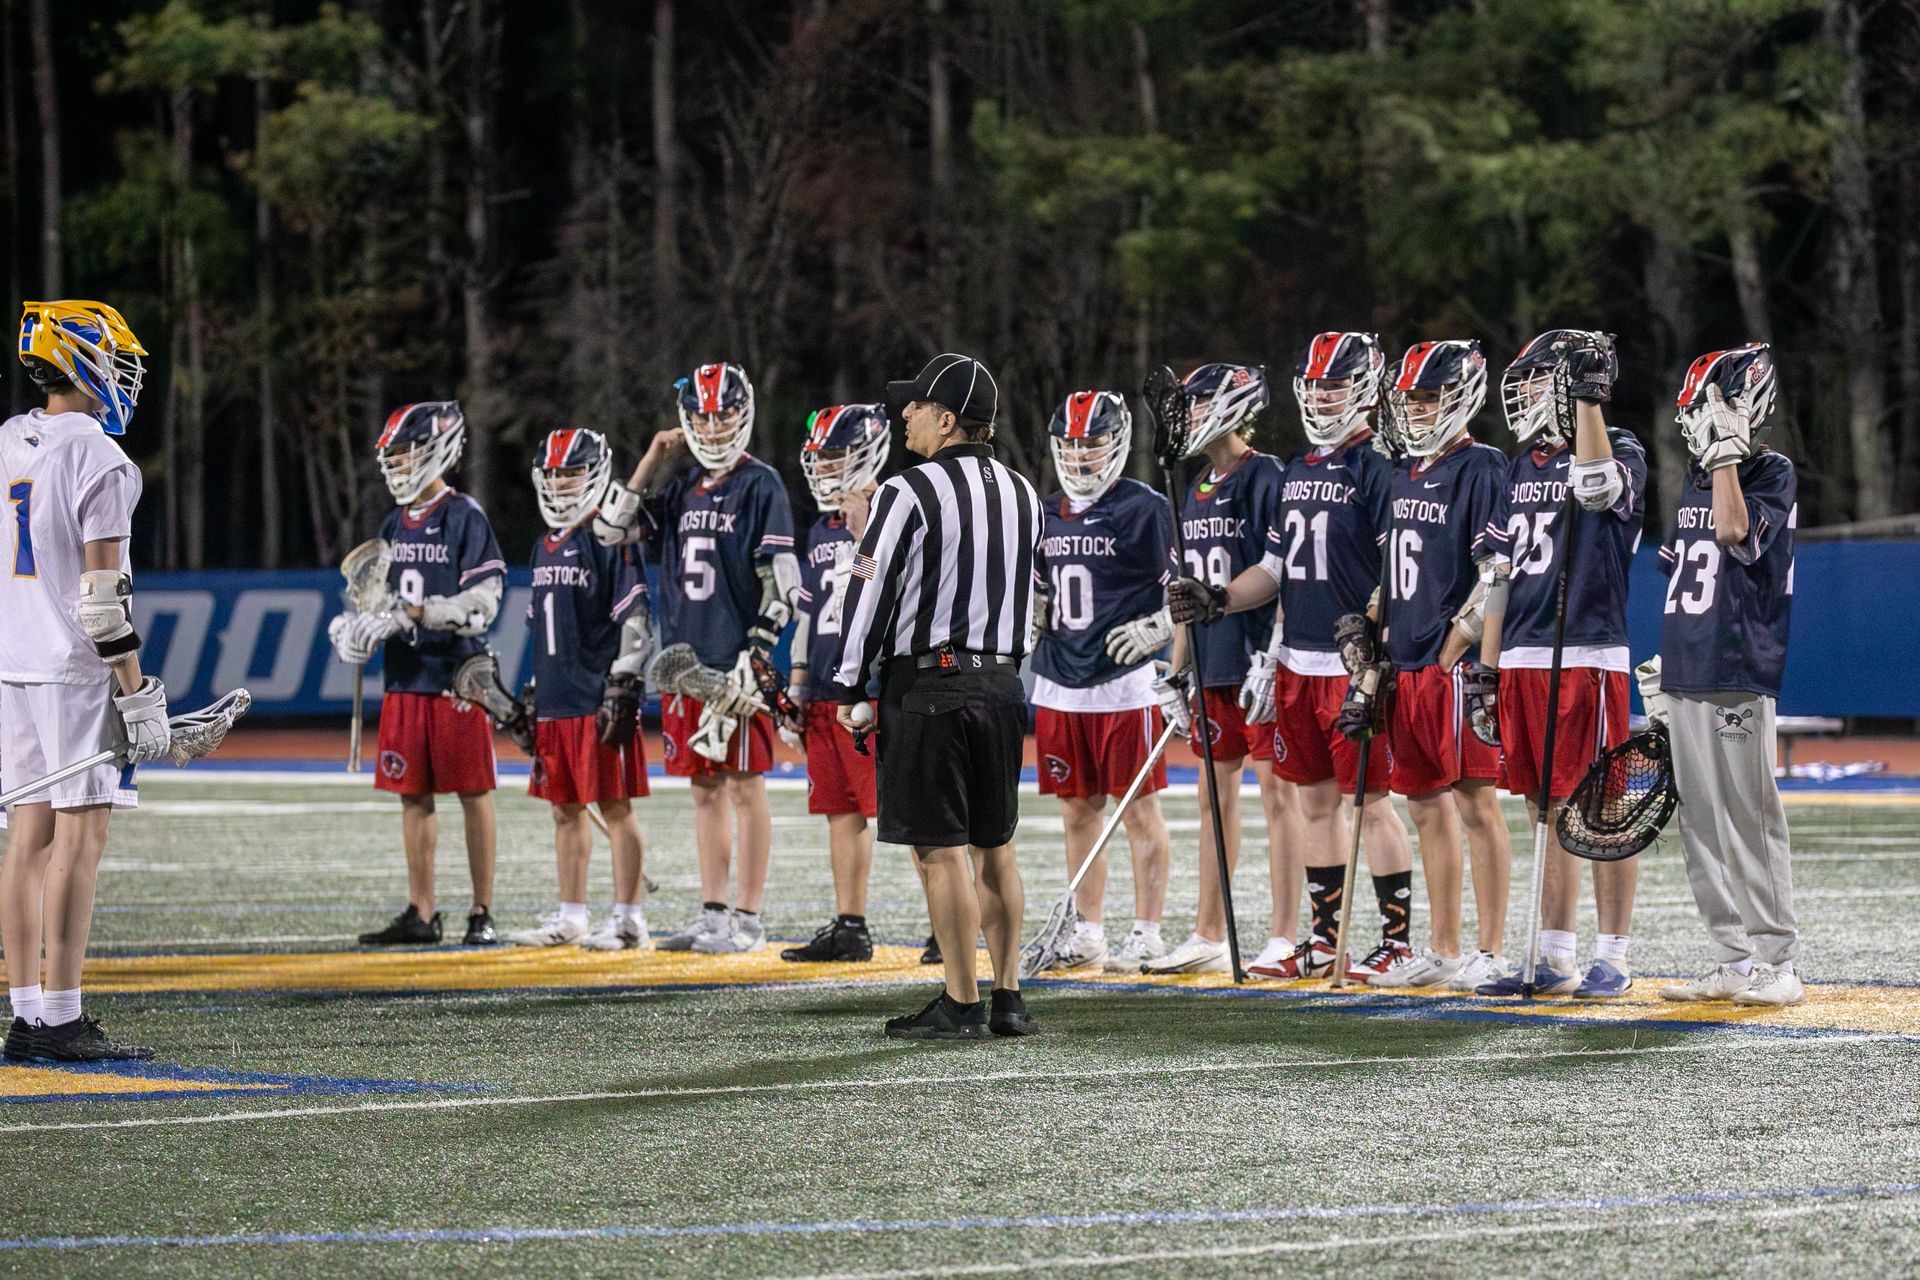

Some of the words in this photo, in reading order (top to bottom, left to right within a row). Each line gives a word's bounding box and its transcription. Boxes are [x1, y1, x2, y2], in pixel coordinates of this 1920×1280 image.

[8, 478, 37, 579] 1
[1284, 509, 1330, 581] 21
[1507, 512, 1554, 579] 25
[682, 536, 716, 601] 5
[1051, 563, 1095, 631] 10
[1389, 528, 1423, 601] 16
[1664, 539, 1721, 615] 23
[543, 592, 557, 656] 1
[817, 569, 842, 635] 2
